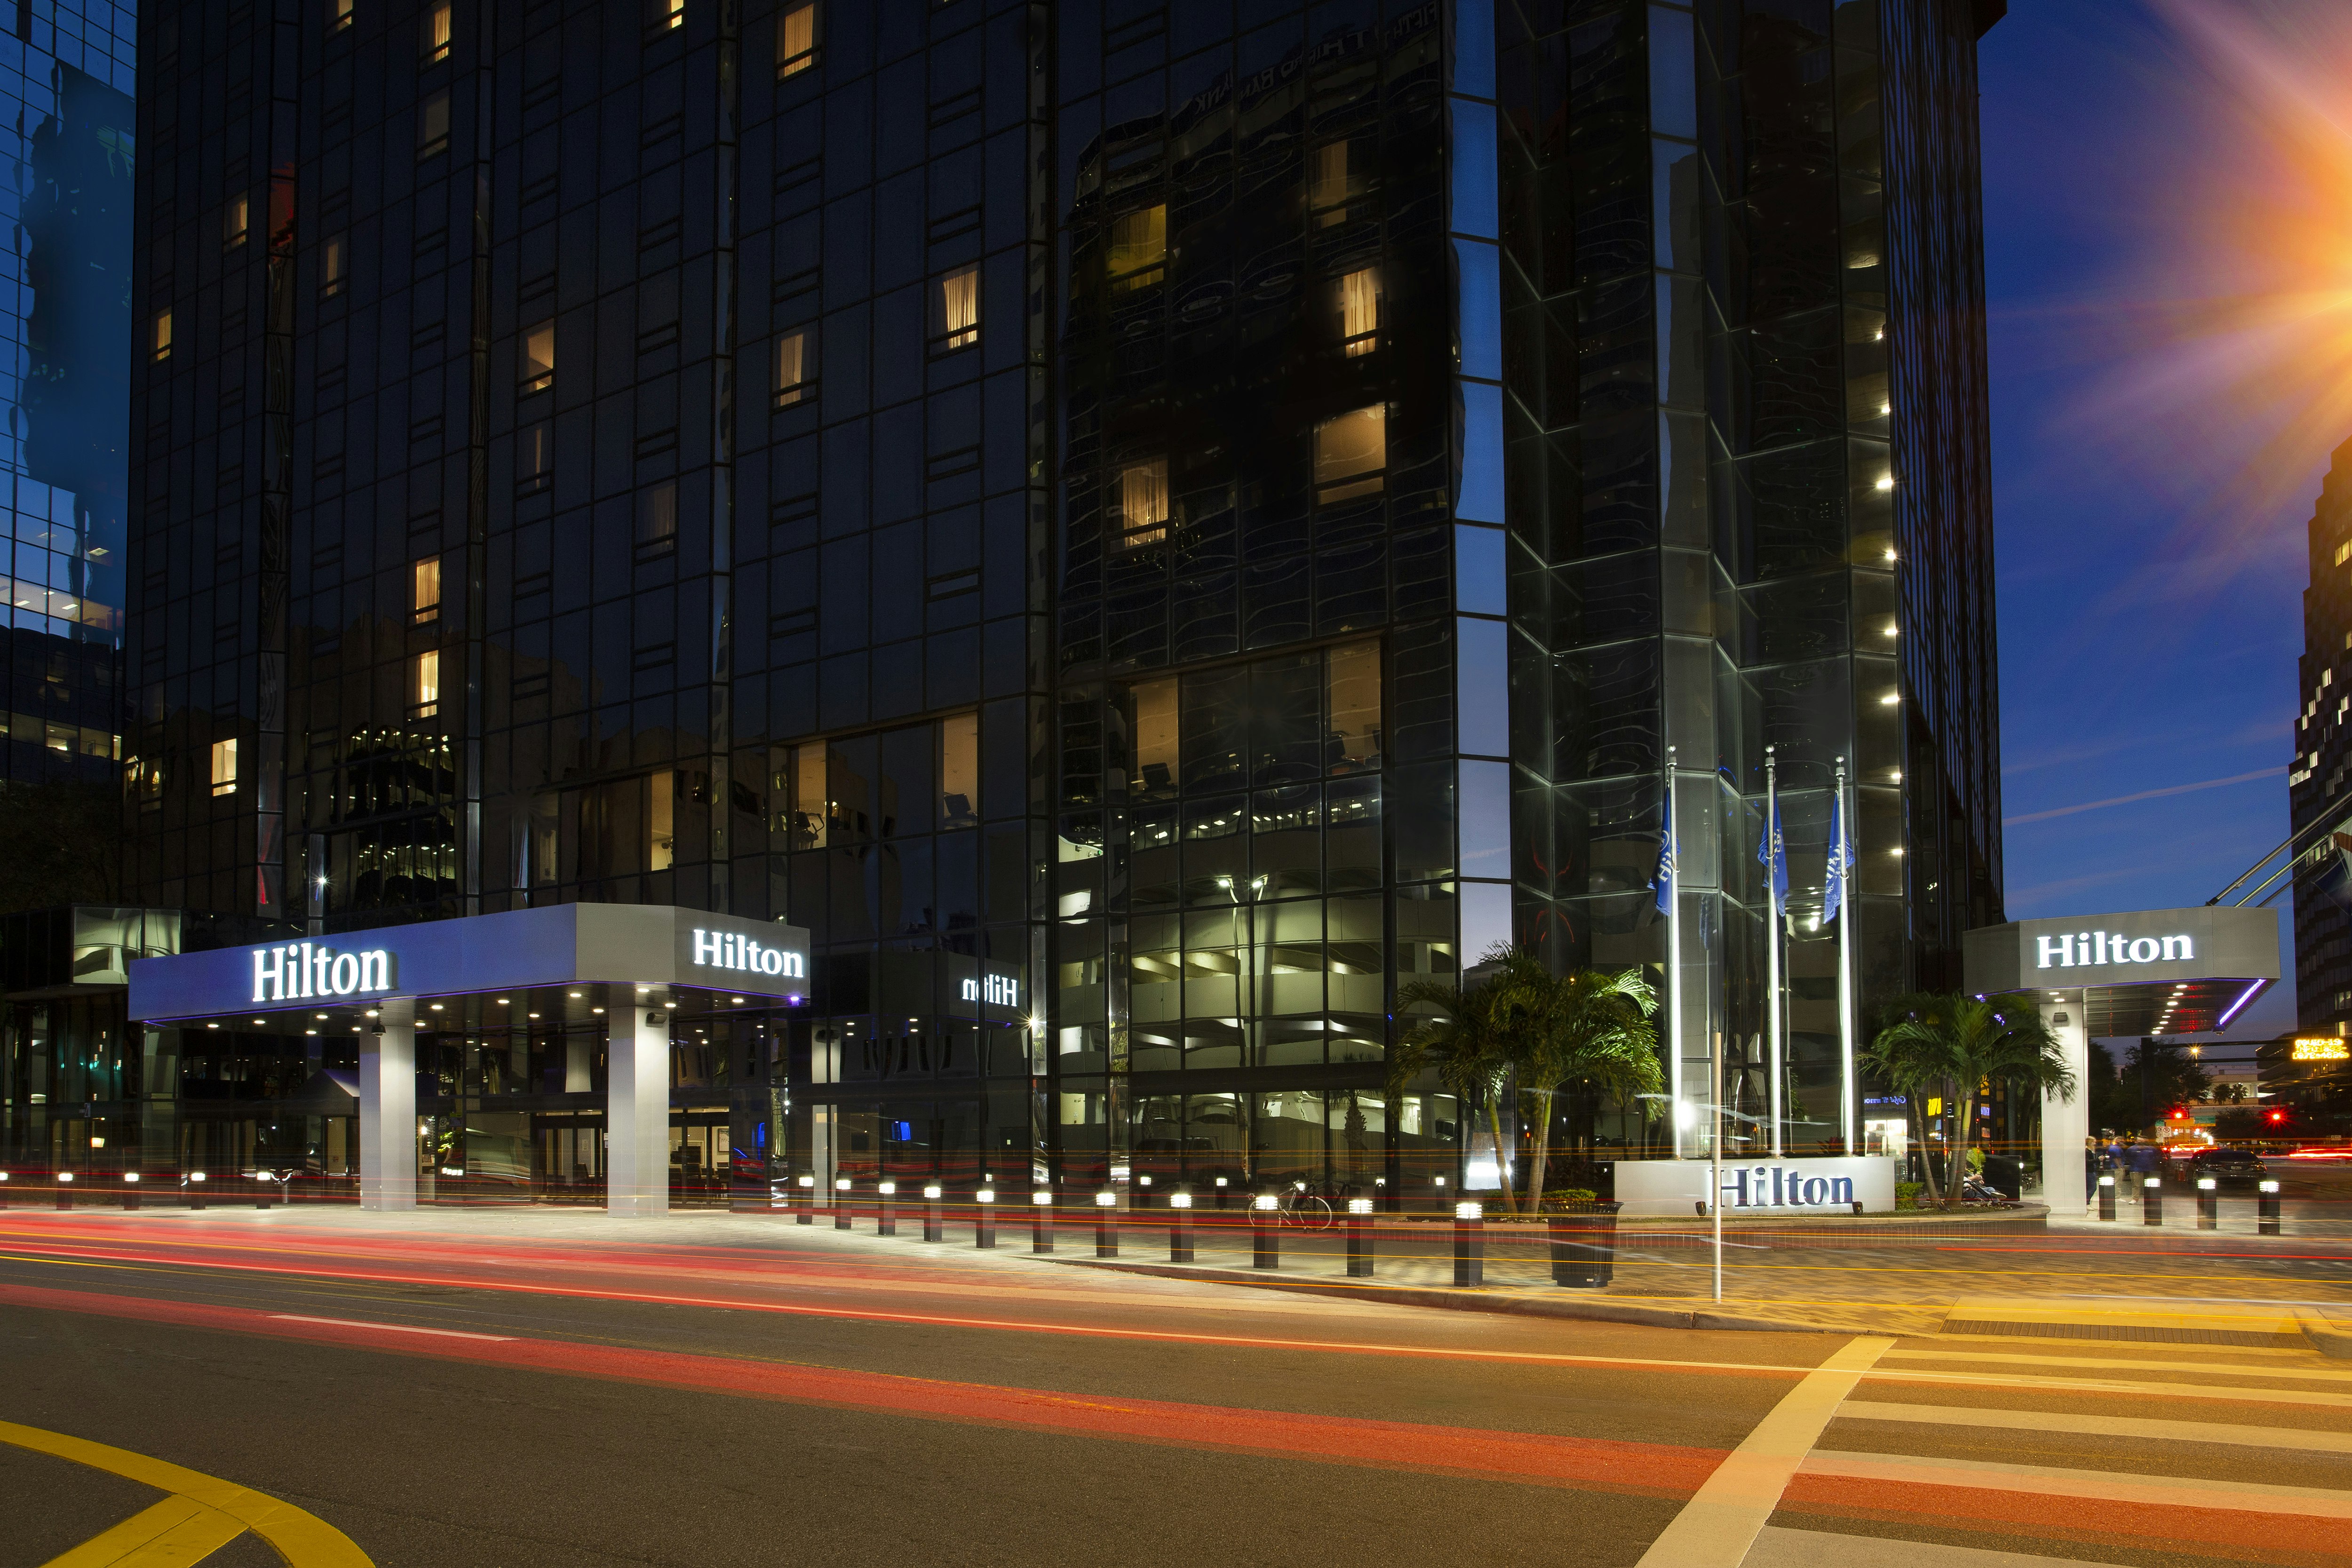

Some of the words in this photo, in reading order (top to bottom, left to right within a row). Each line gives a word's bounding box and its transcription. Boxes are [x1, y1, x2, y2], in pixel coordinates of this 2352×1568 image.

[693, 929, 803, 978] Hilton
[2037, 931, 2194, 969] Hilton
[253, 942, 389, 1003] Hilton
[1709, 1167, 1853, 1207] Hilton
